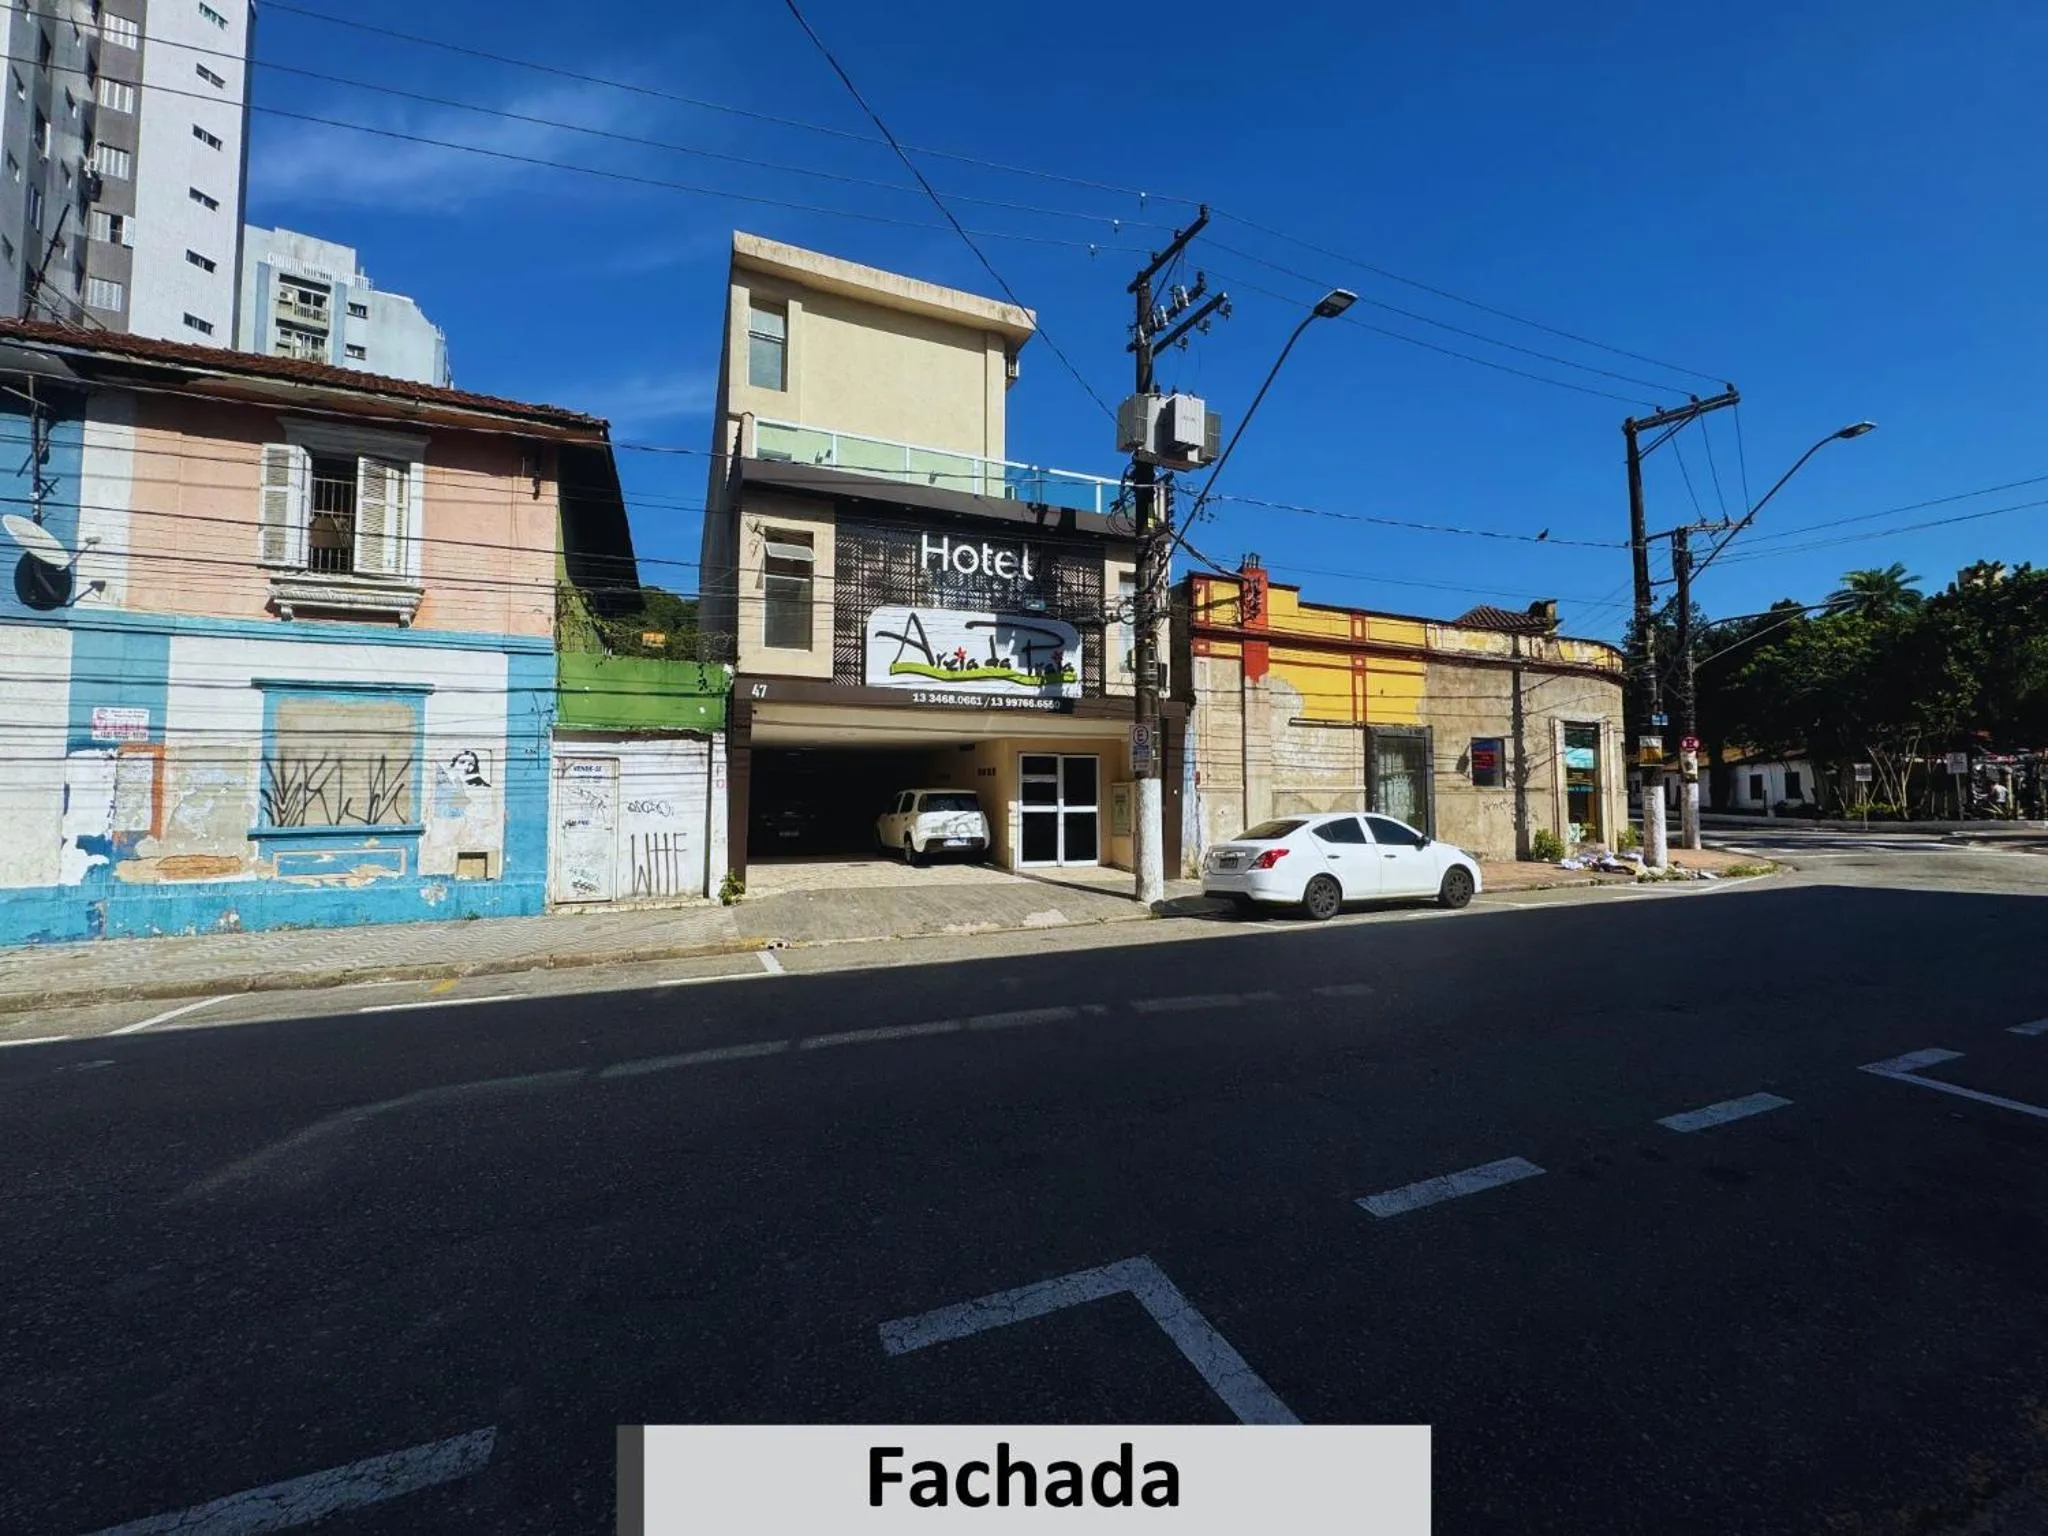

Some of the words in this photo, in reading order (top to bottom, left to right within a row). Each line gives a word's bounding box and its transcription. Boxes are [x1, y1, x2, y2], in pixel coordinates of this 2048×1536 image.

[921, 531, 1034, 581] Hotel
[874, 612, 980, 671] Areia
[964, 620, 1076, 678] Praia
[984, 634, 1011, 670] da
[751, 683, 768, 698] 47
[912, 692, 926, 703] 13
